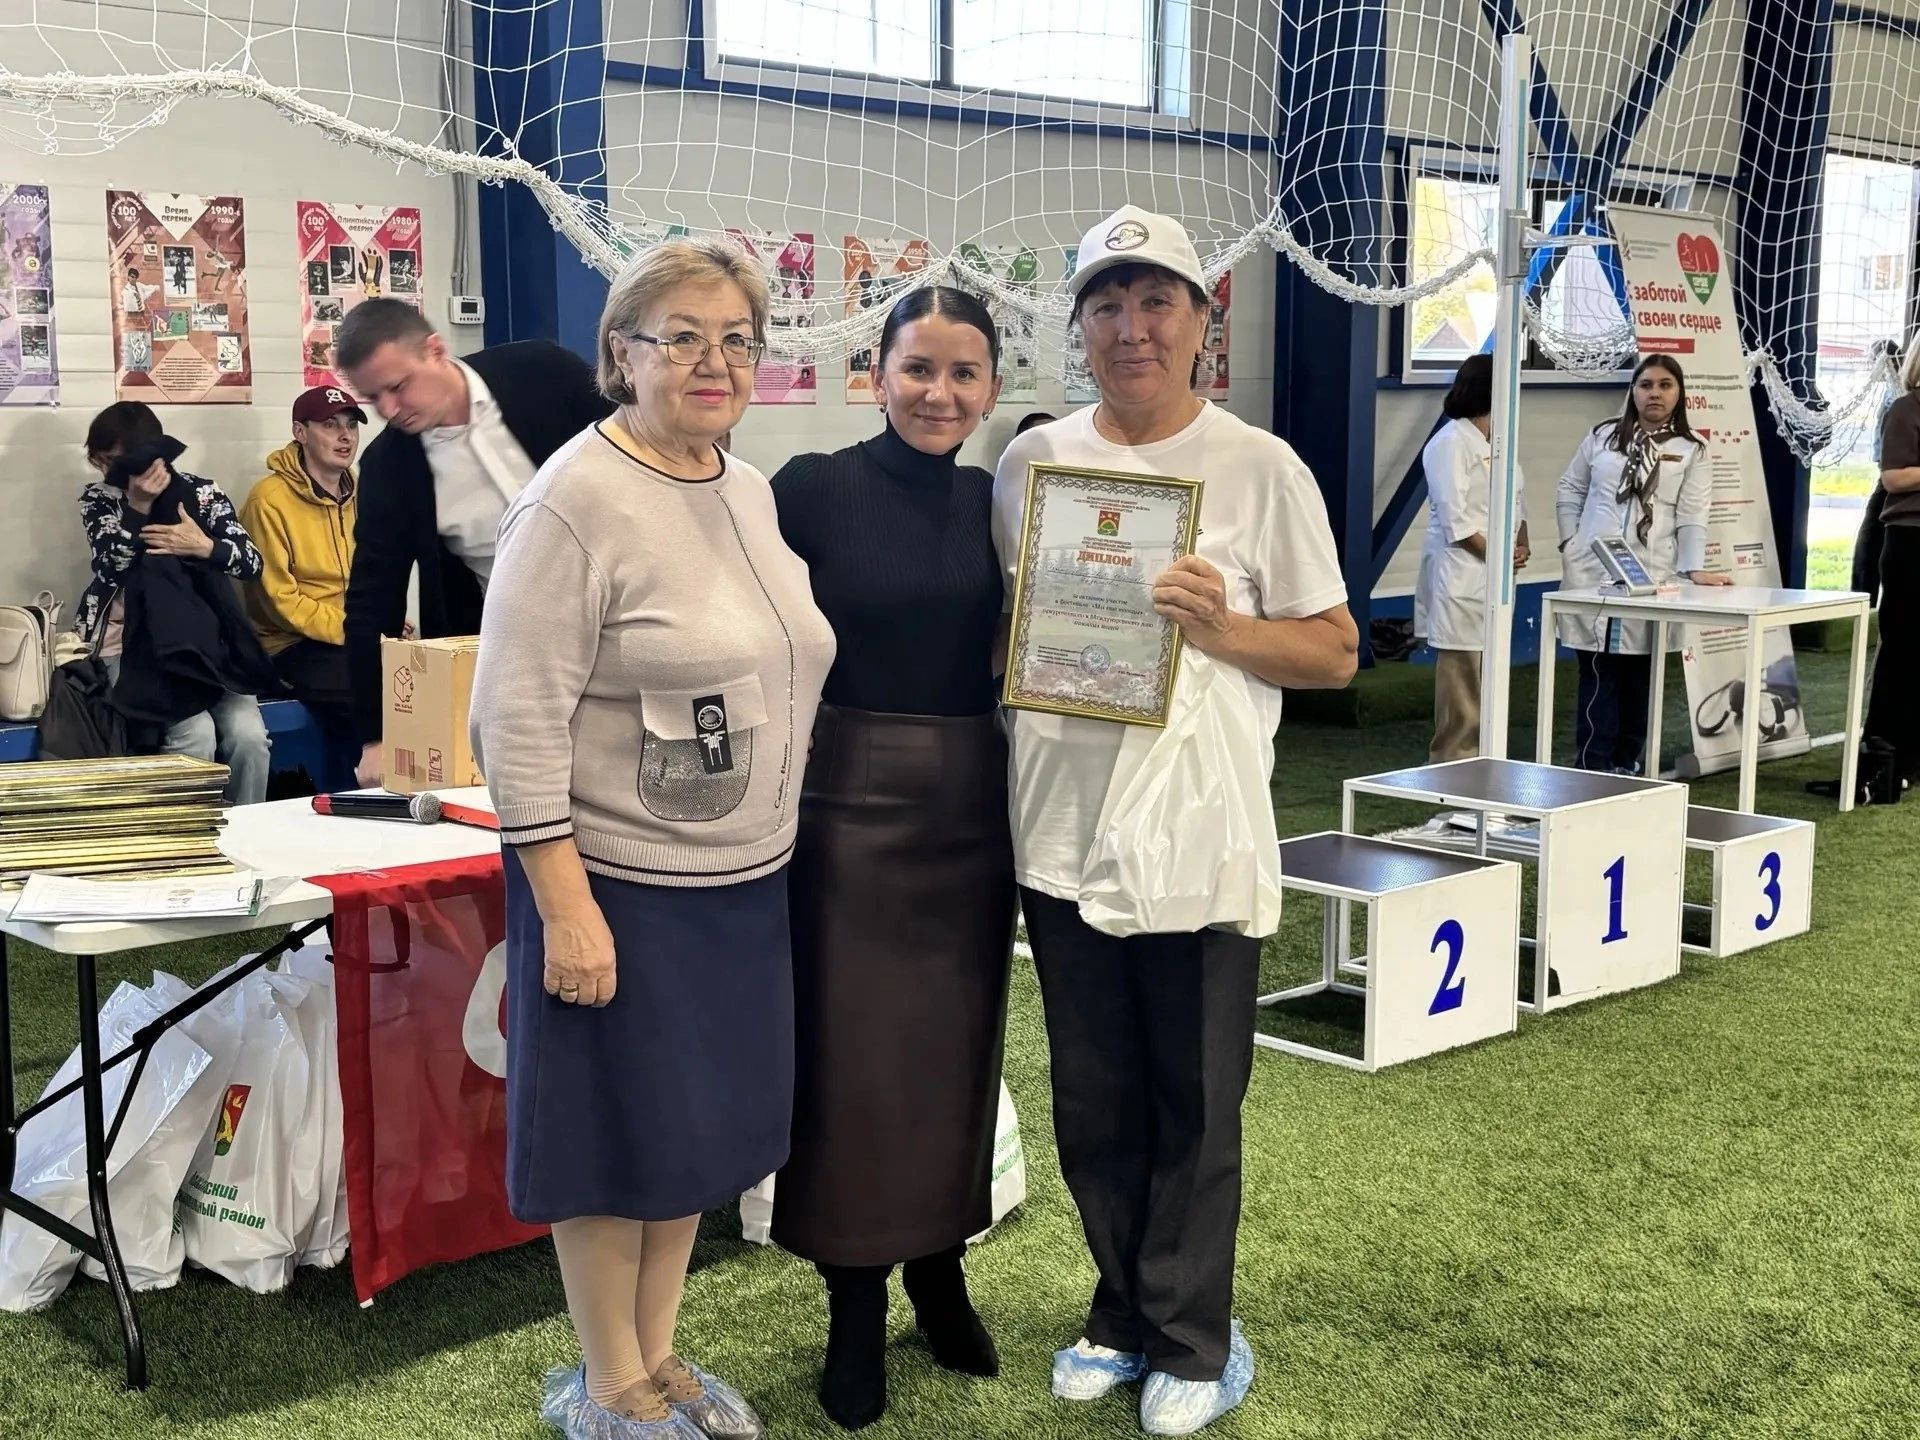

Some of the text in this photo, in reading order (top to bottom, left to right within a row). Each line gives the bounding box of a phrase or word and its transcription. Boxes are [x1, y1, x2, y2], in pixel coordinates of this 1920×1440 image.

[117, 205, 136, 216] 100
[307, 216, 325, 226] 100
[1634, 281, 1687, 303] заботой
[1638, 311, 1678, 329] своем
[1680, 313, 1722, 334] сердце
[1076, 550, 1133, 567] ДИПЛОМ
[1601, 855, 1629, 945] 1
[1754, 851, 1782, 932] 3
[1428, 919, 1466, 1017] 2
[219, 1207, 266, 1230] район
